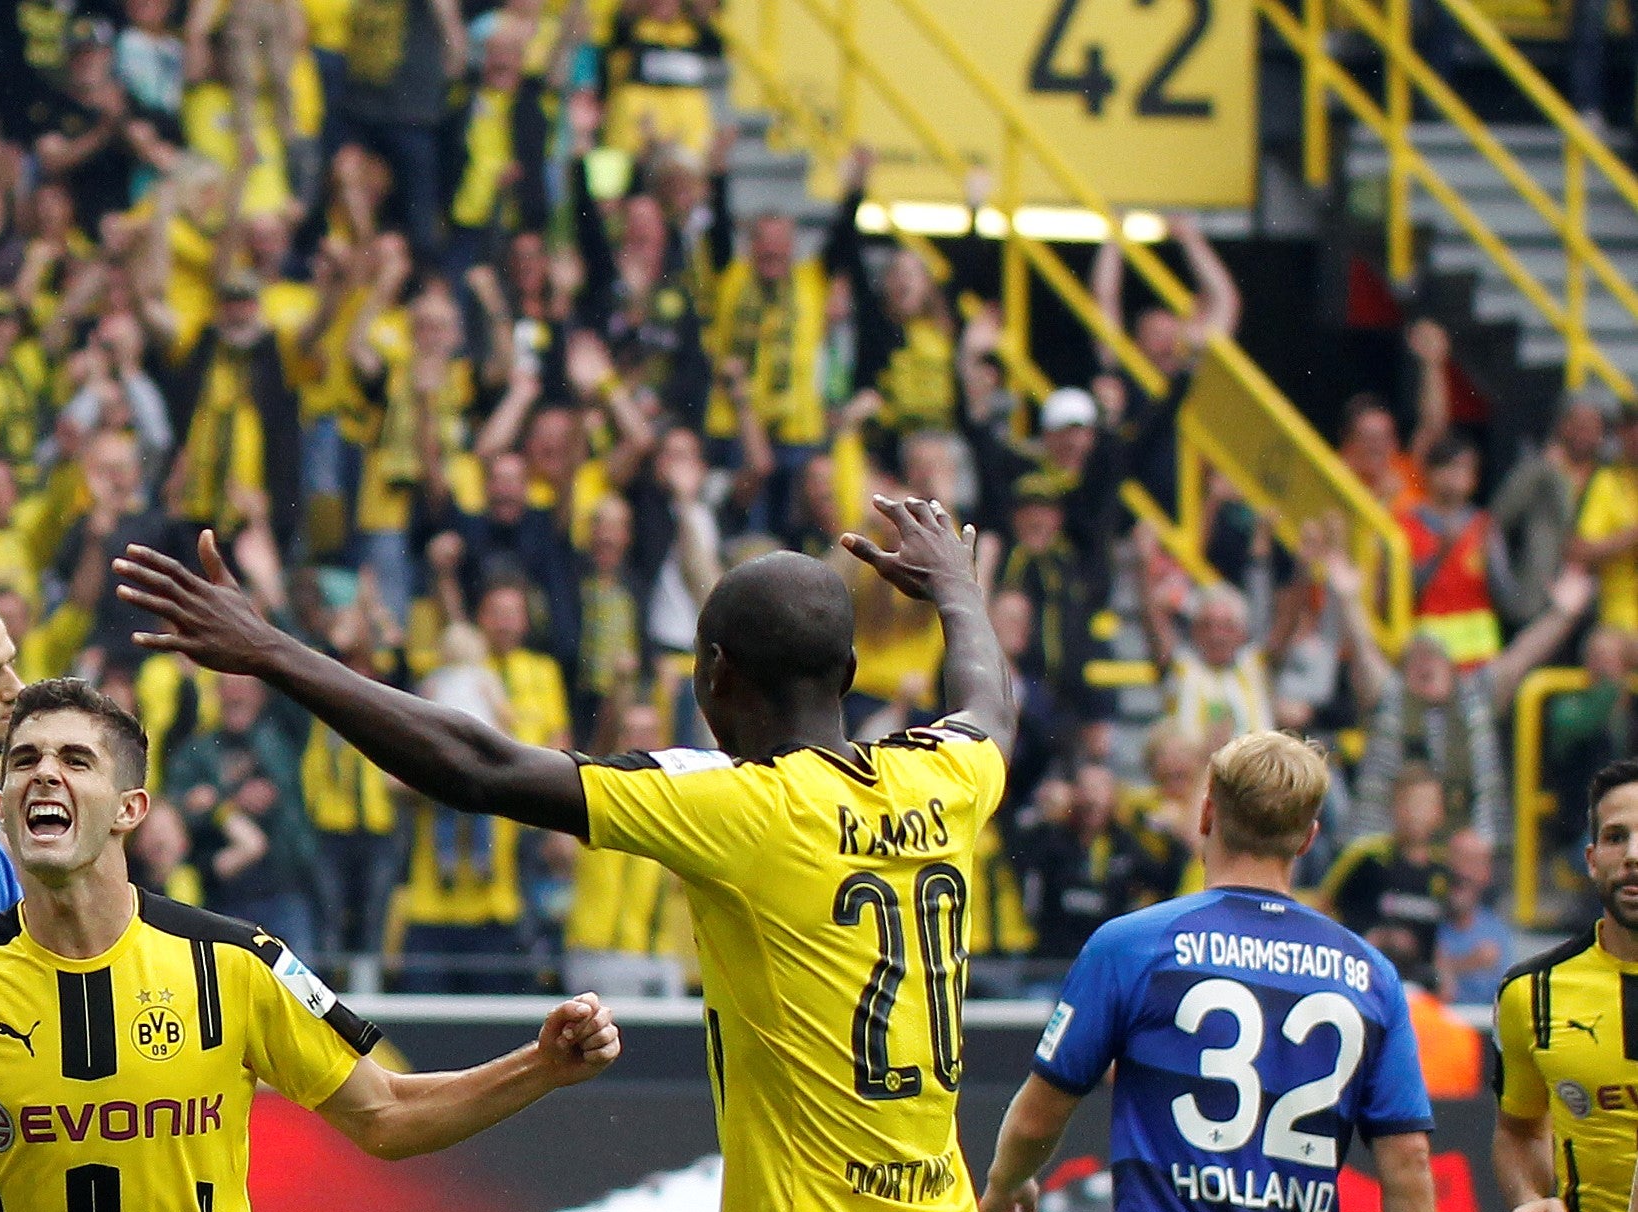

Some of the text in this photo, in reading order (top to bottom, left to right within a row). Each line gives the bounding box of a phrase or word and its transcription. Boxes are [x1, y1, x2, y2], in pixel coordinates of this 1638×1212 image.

[1029, 0, 1215, 117] 42
[837, 797, 949, 856] RAMOS
[833, 862, 968, 1100] 20
[1174, 931, 1370, 993] SV DARMSTADT 98
[138, 1011, 181, 1046] BVB
[1170, 977, 1366, 1169] 32
[19, 1093, 225, 1144] EVONIK
